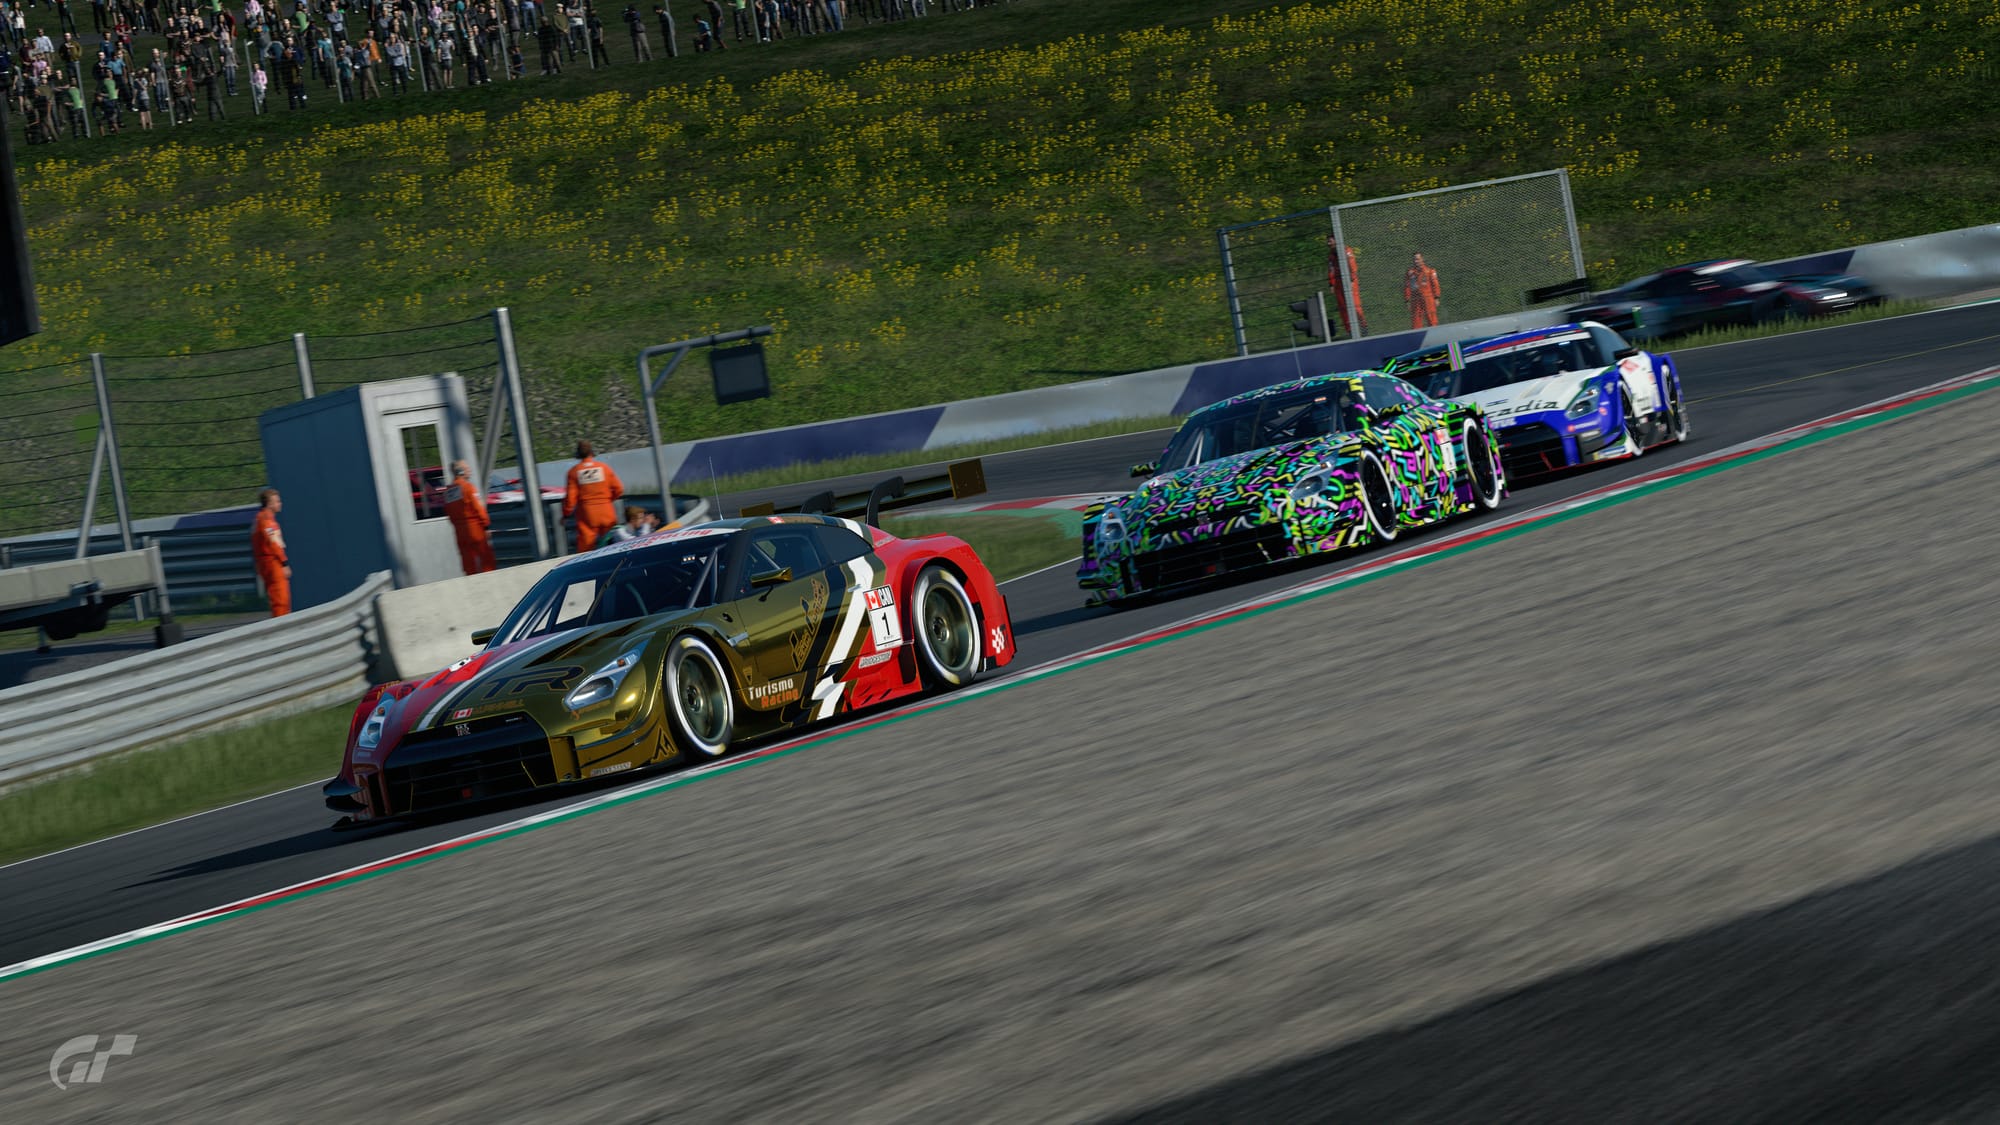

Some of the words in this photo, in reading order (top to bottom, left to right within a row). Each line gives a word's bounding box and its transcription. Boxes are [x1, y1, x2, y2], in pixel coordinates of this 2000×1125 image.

[878, 586, 895, 607] CAN
[882, 611, 891, 636] 1
[748, 678, 794, 700] Turismo
[761, 688, 800, 708] Racing
